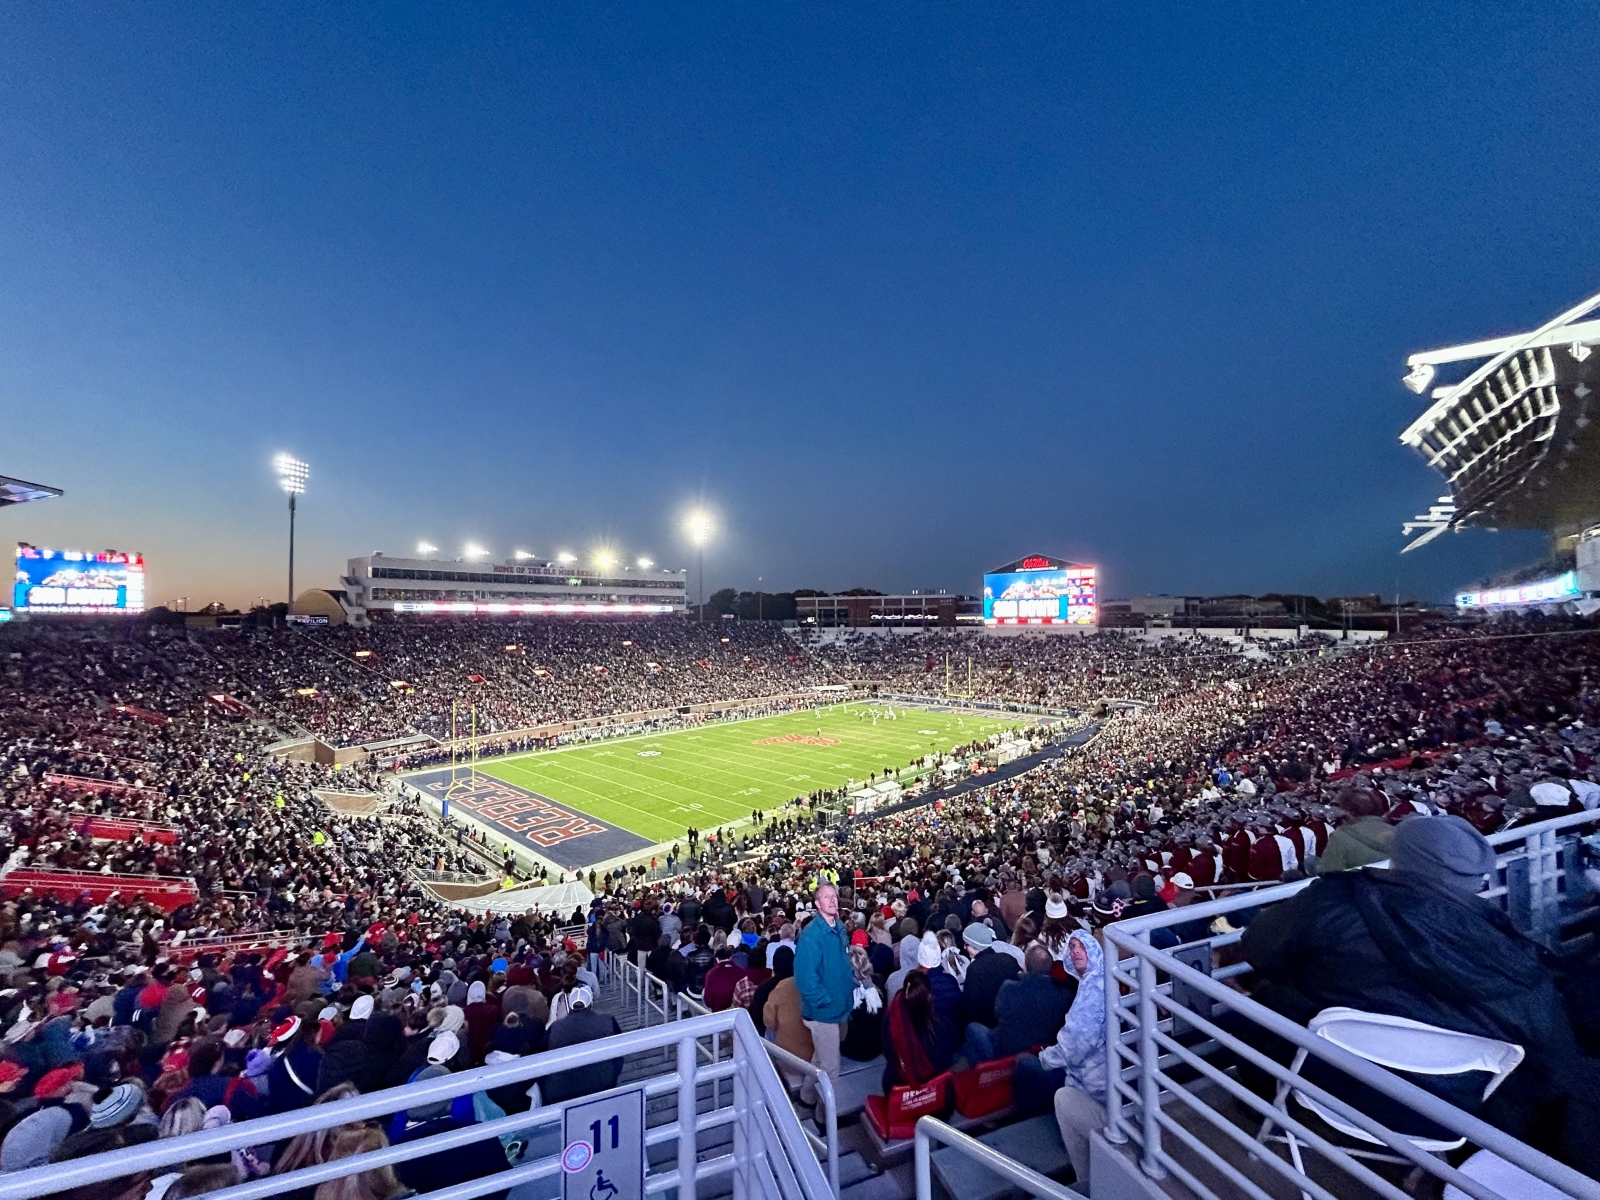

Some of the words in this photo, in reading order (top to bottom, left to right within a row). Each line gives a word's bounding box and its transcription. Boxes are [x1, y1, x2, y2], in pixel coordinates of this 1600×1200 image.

[493, 565, 514, 573] HOME
[528, 567, 542, 575] THE
[1022, 558, 1033, 568] Ole
[426, 776, 608, 847] REBELS
[589, 1114, 619, 1155] 11
